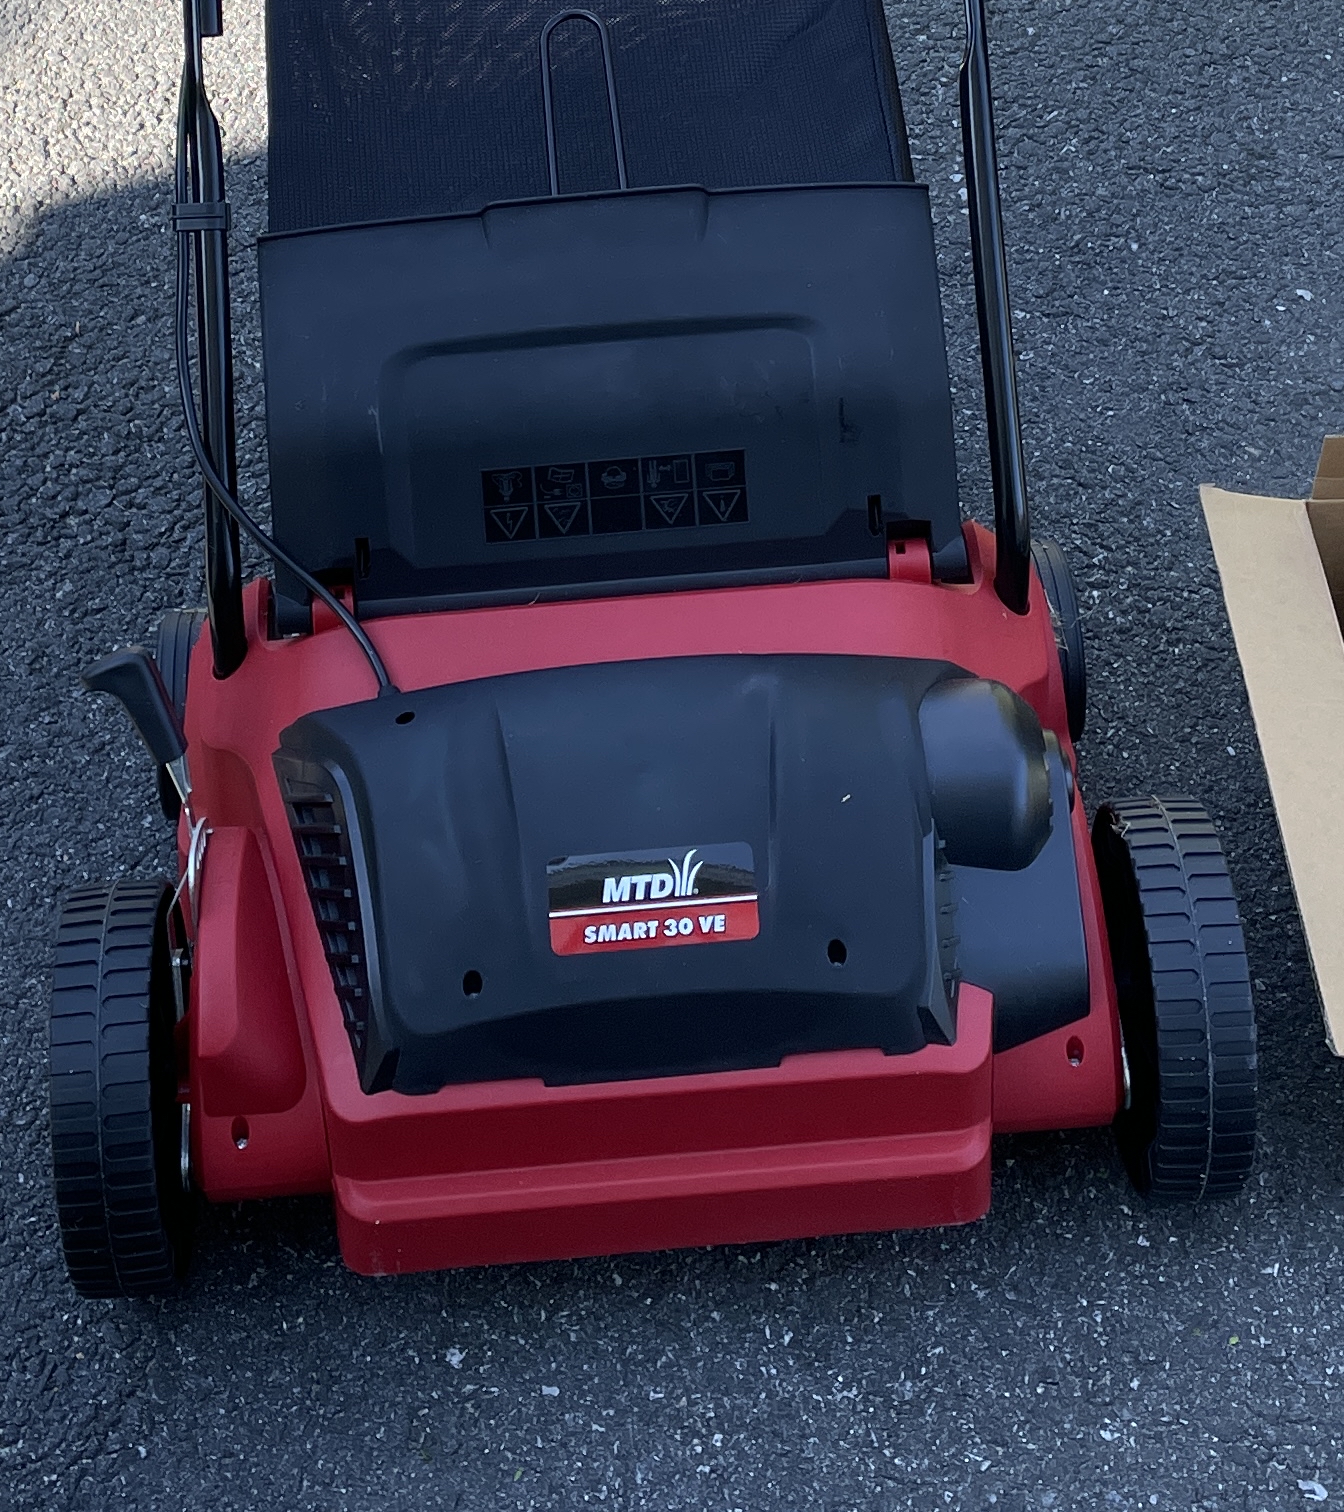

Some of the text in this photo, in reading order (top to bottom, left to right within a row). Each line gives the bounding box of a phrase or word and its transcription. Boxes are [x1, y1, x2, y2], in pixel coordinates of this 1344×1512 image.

[602, 873, 674, 903] MTD
[584, 914, 726, 943] SMART 30 VE
